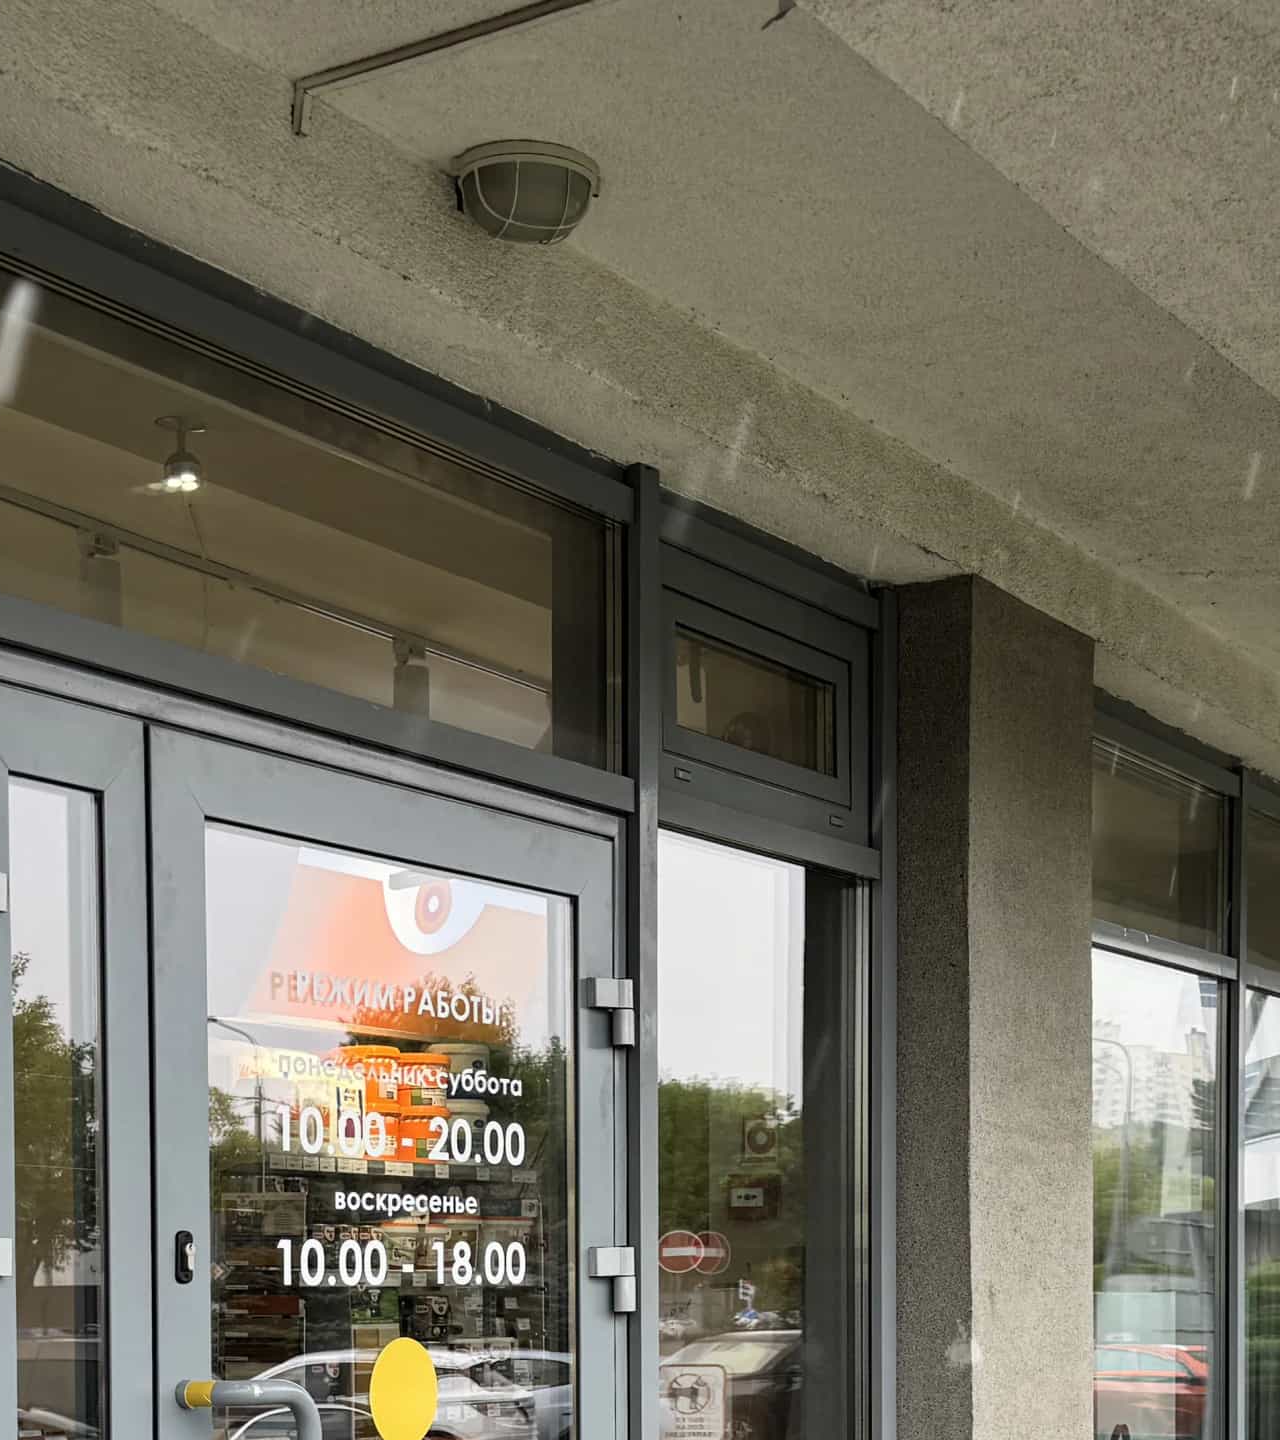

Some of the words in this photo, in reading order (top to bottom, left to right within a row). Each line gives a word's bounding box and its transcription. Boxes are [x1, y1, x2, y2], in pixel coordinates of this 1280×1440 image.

[295, 970, 395, 1012] РЕЖИМ
[276, 1105, 386, 1157] 10.00
[428, 1117, 525, 1166] 20.00
[335, 1191, 478, 1216] воскресенье
[276, 1239, 388, 1287] 10.00
[432, 1241, 526, 1286] 18.00
